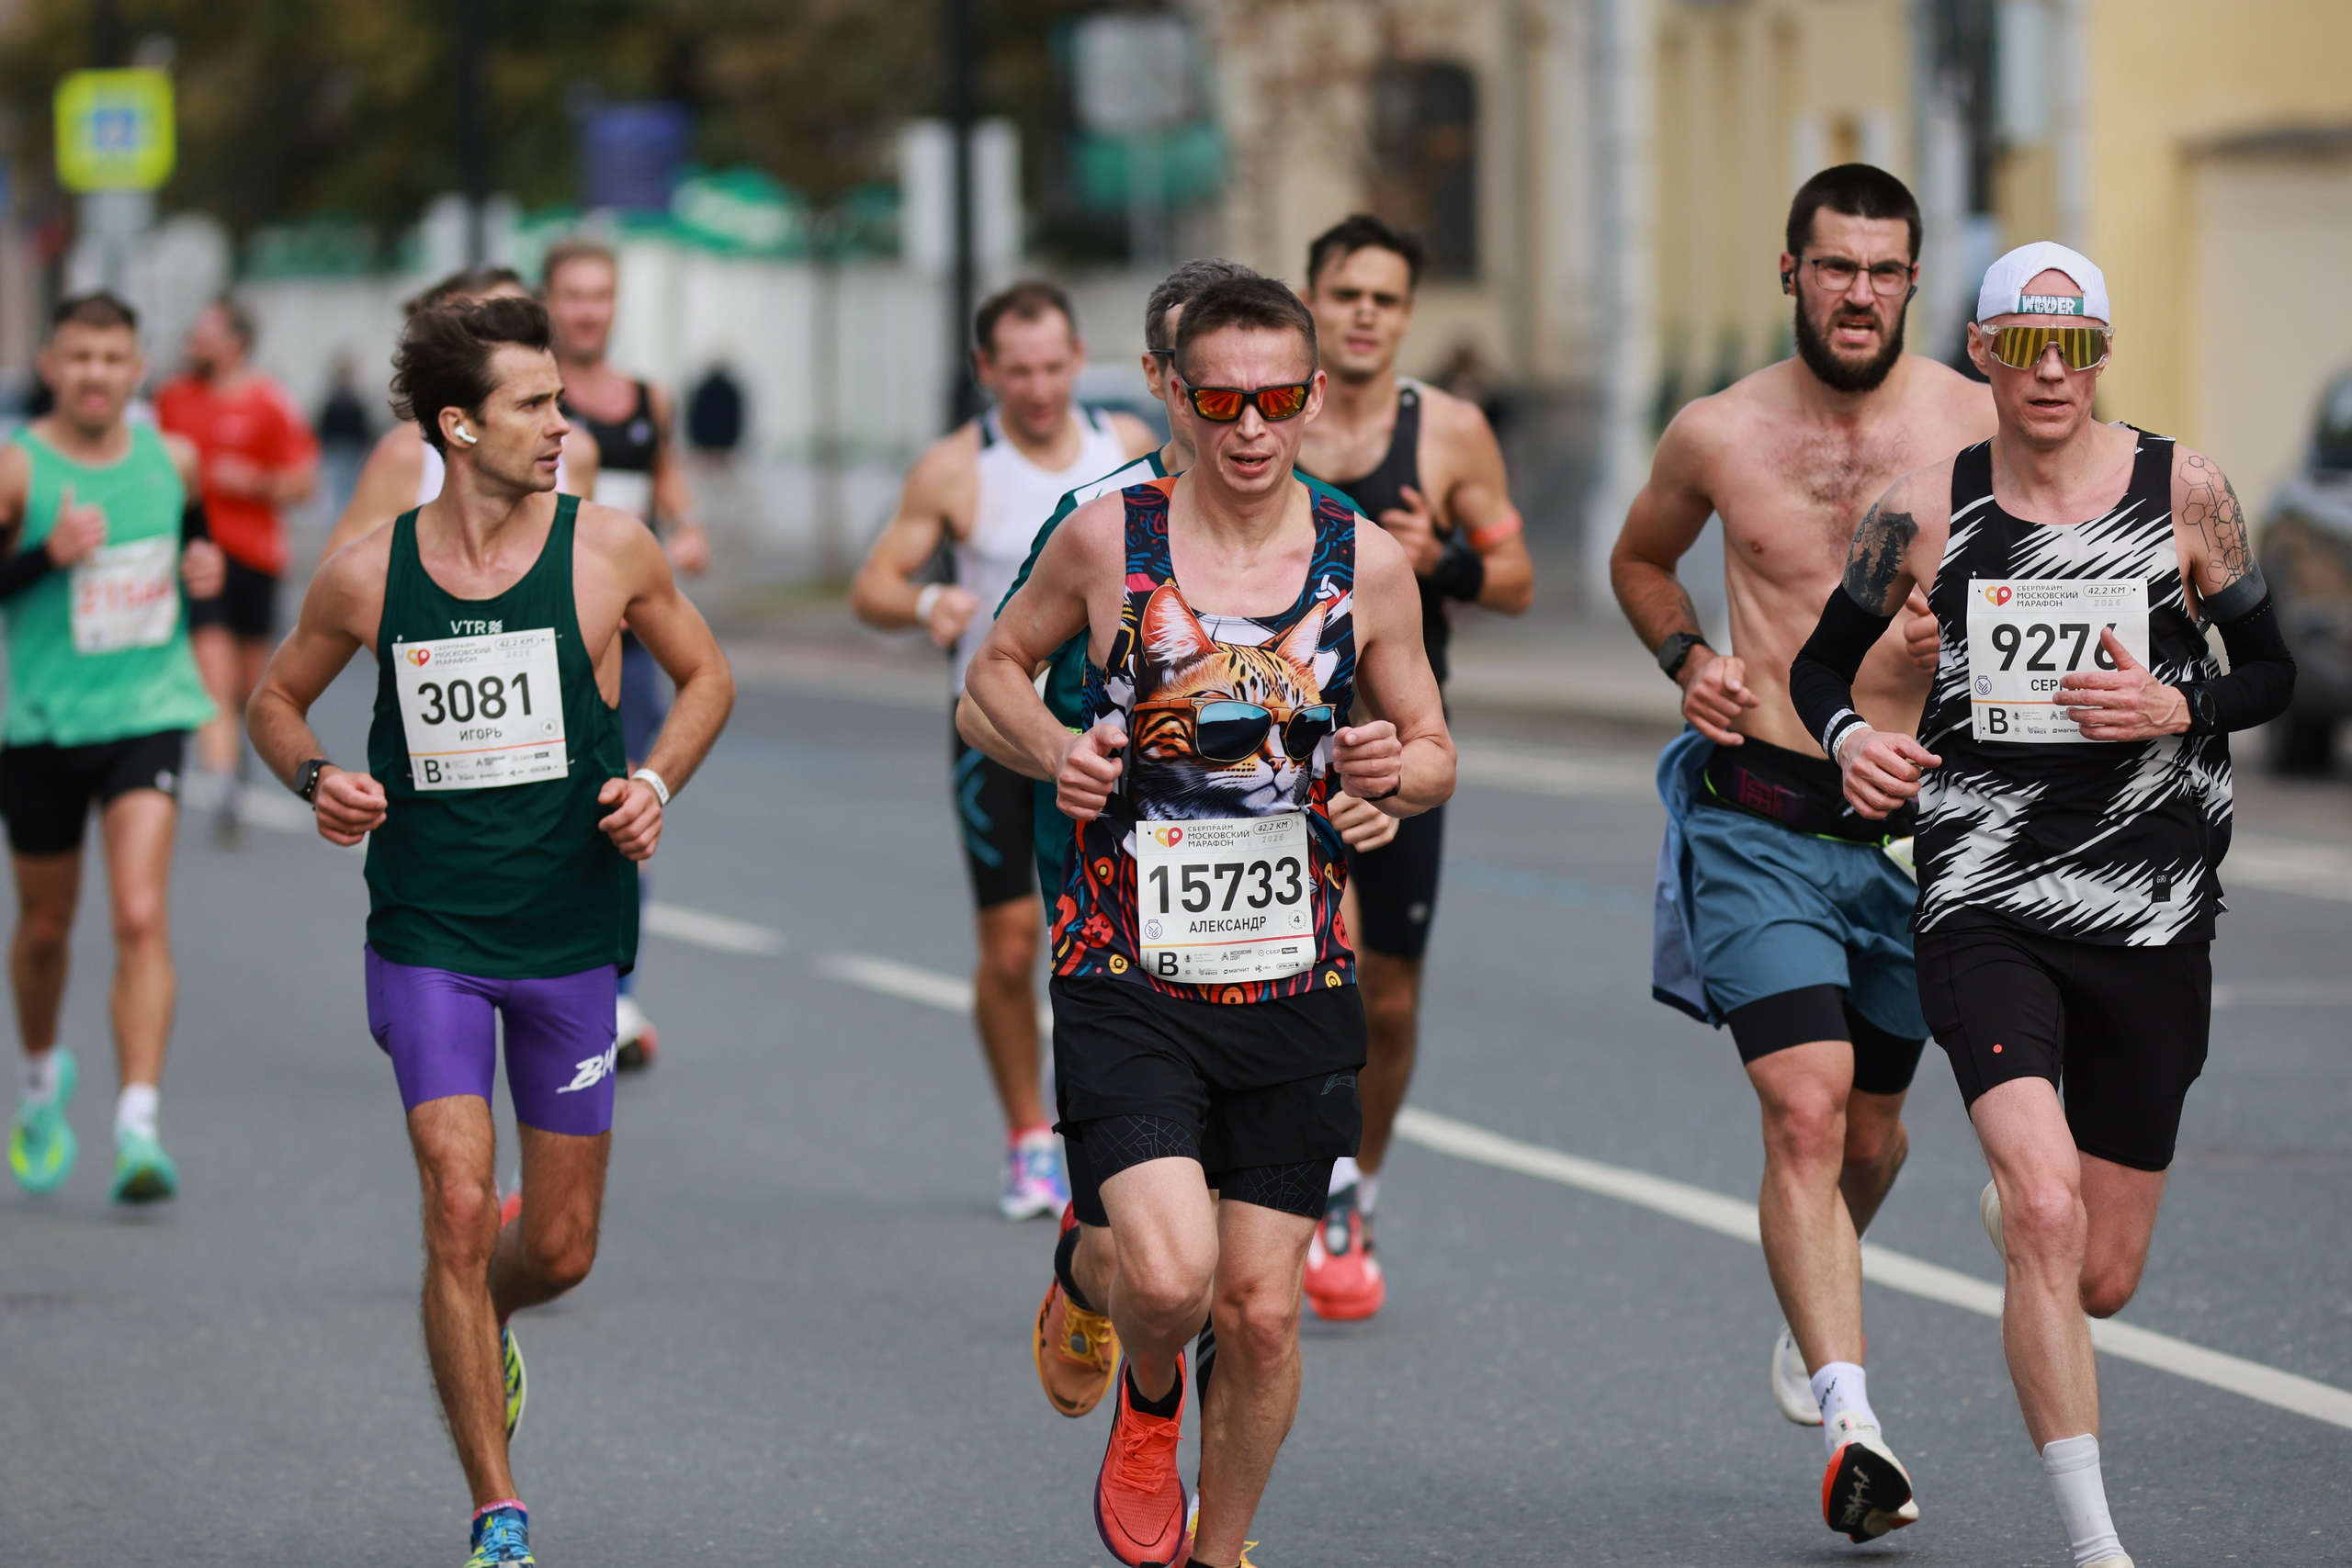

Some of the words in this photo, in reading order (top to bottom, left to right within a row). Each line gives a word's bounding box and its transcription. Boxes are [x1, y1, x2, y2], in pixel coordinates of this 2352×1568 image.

[2017, 591, 2078, 599] МОСКОВСКИЙ
[2088, 587, 2108, 595] 42,2
[435, 646, 492, 659] МОСКОВСКИЙ
[435, 657, 477, 666] МАРАФОН
[418, 672, 532, 726] 3081
[459, 727, 503, 741] ИГОРЬ
[1258, 823, 1273, 832] 42,2
[1188, 829, 1250, 840] МОСКОВСКИЙ
[1188, 840, 1234, 848] МАРАФОН
[1149, 856, 1303, 914] 15733
[1294, 915, 1301, 923] 4
[1189, 916, 1267, 933] АЛЕКСАНДР
